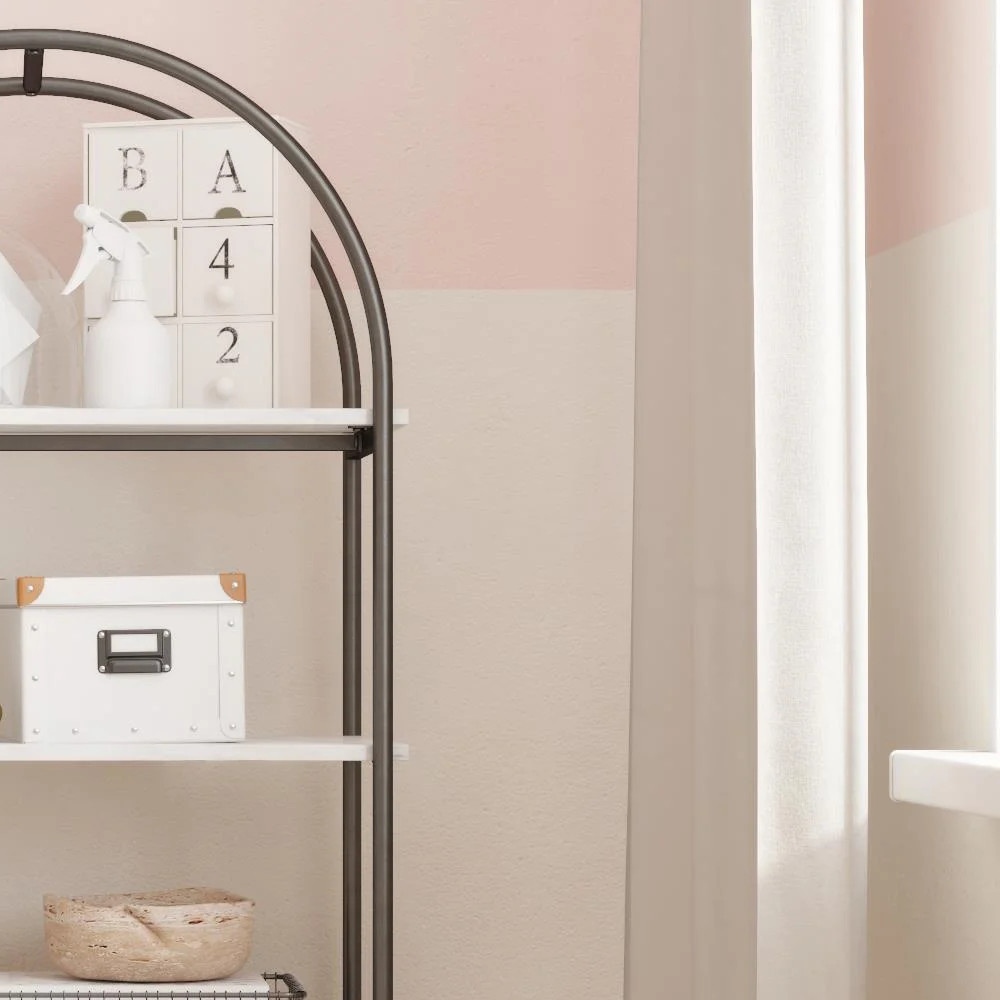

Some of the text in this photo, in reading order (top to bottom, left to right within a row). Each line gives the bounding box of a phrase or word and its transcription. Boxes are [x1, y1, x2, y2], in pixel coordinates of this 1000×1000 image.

[118, 147, 147, 191] B
[208, 149, 246, 194] A
[208, 238, 235, 280] 4
[216, 326, 240, 364] 2
